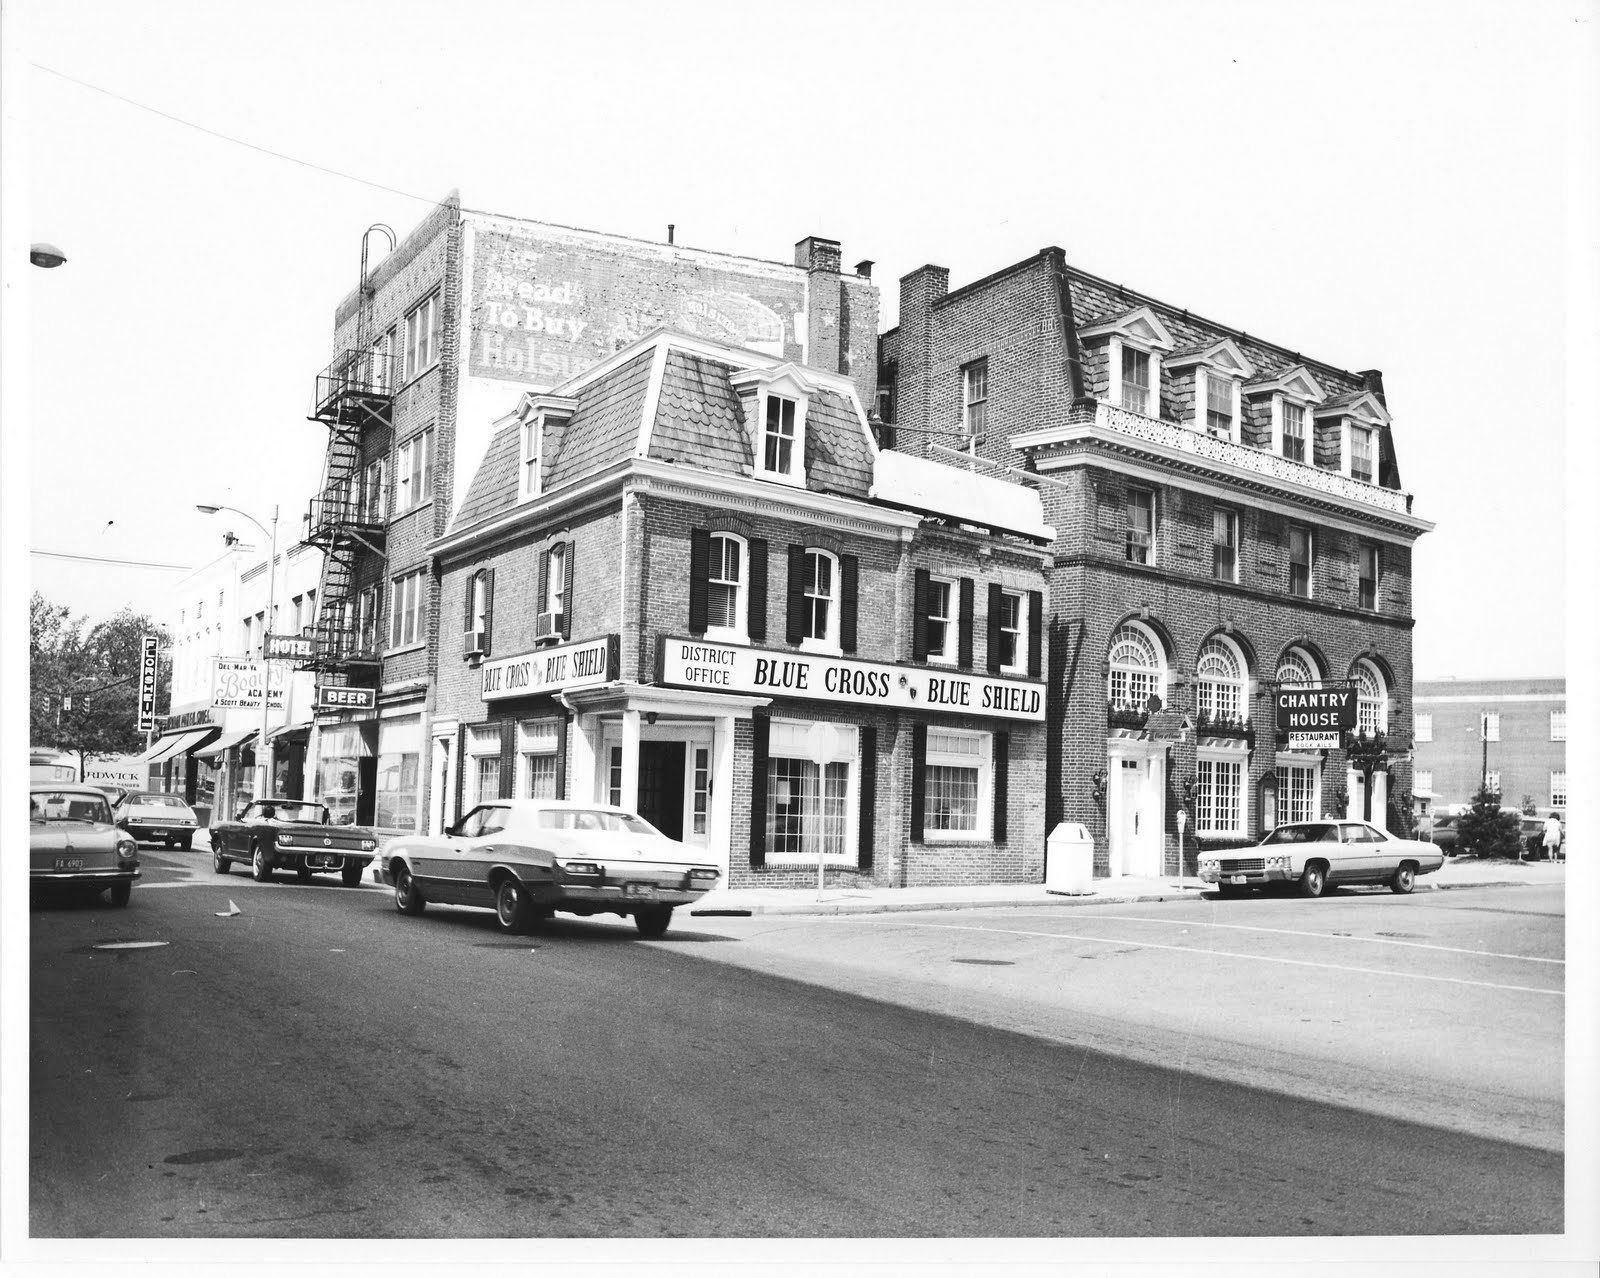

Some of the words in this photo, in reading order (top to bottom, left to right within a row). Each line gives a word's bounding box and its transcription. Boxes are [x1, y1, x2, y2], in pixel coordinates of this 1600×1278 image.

[522, 304, 588, 342] Buy
[269, 639, 314, 656] HOTEL
[681, 645, 737, 666] DISTRICT
[484, 667, 502, 692] BLUE
[505, 661, 531, 690] CROSS
[545, 654, 568, 683] BLUE
[572, 646, 606, 678] SHIELD
[685, 666, 730, 685] OFFICE
[142, 640, 156, 720] FLORSHEIM
[754, 658, 810, 690] BLUE
[824, 666, 890, 698] CROSS
[927, 678, 971, 706] BLUE
[982, 684, 1041, 713] SHIELD
[247, 689, 284, 698] ACAEMY
[327, 691, 367, 704] BEER
[1279, 693, 1349, 708] CHANTRY
[239, 699, 260, 707] BEAUTY
[1289, 712, 1339, 726] HOUSE
[1289, 732, 1339, 741] RESTAURANT
[85, 771, 139, 781] RDWICK
